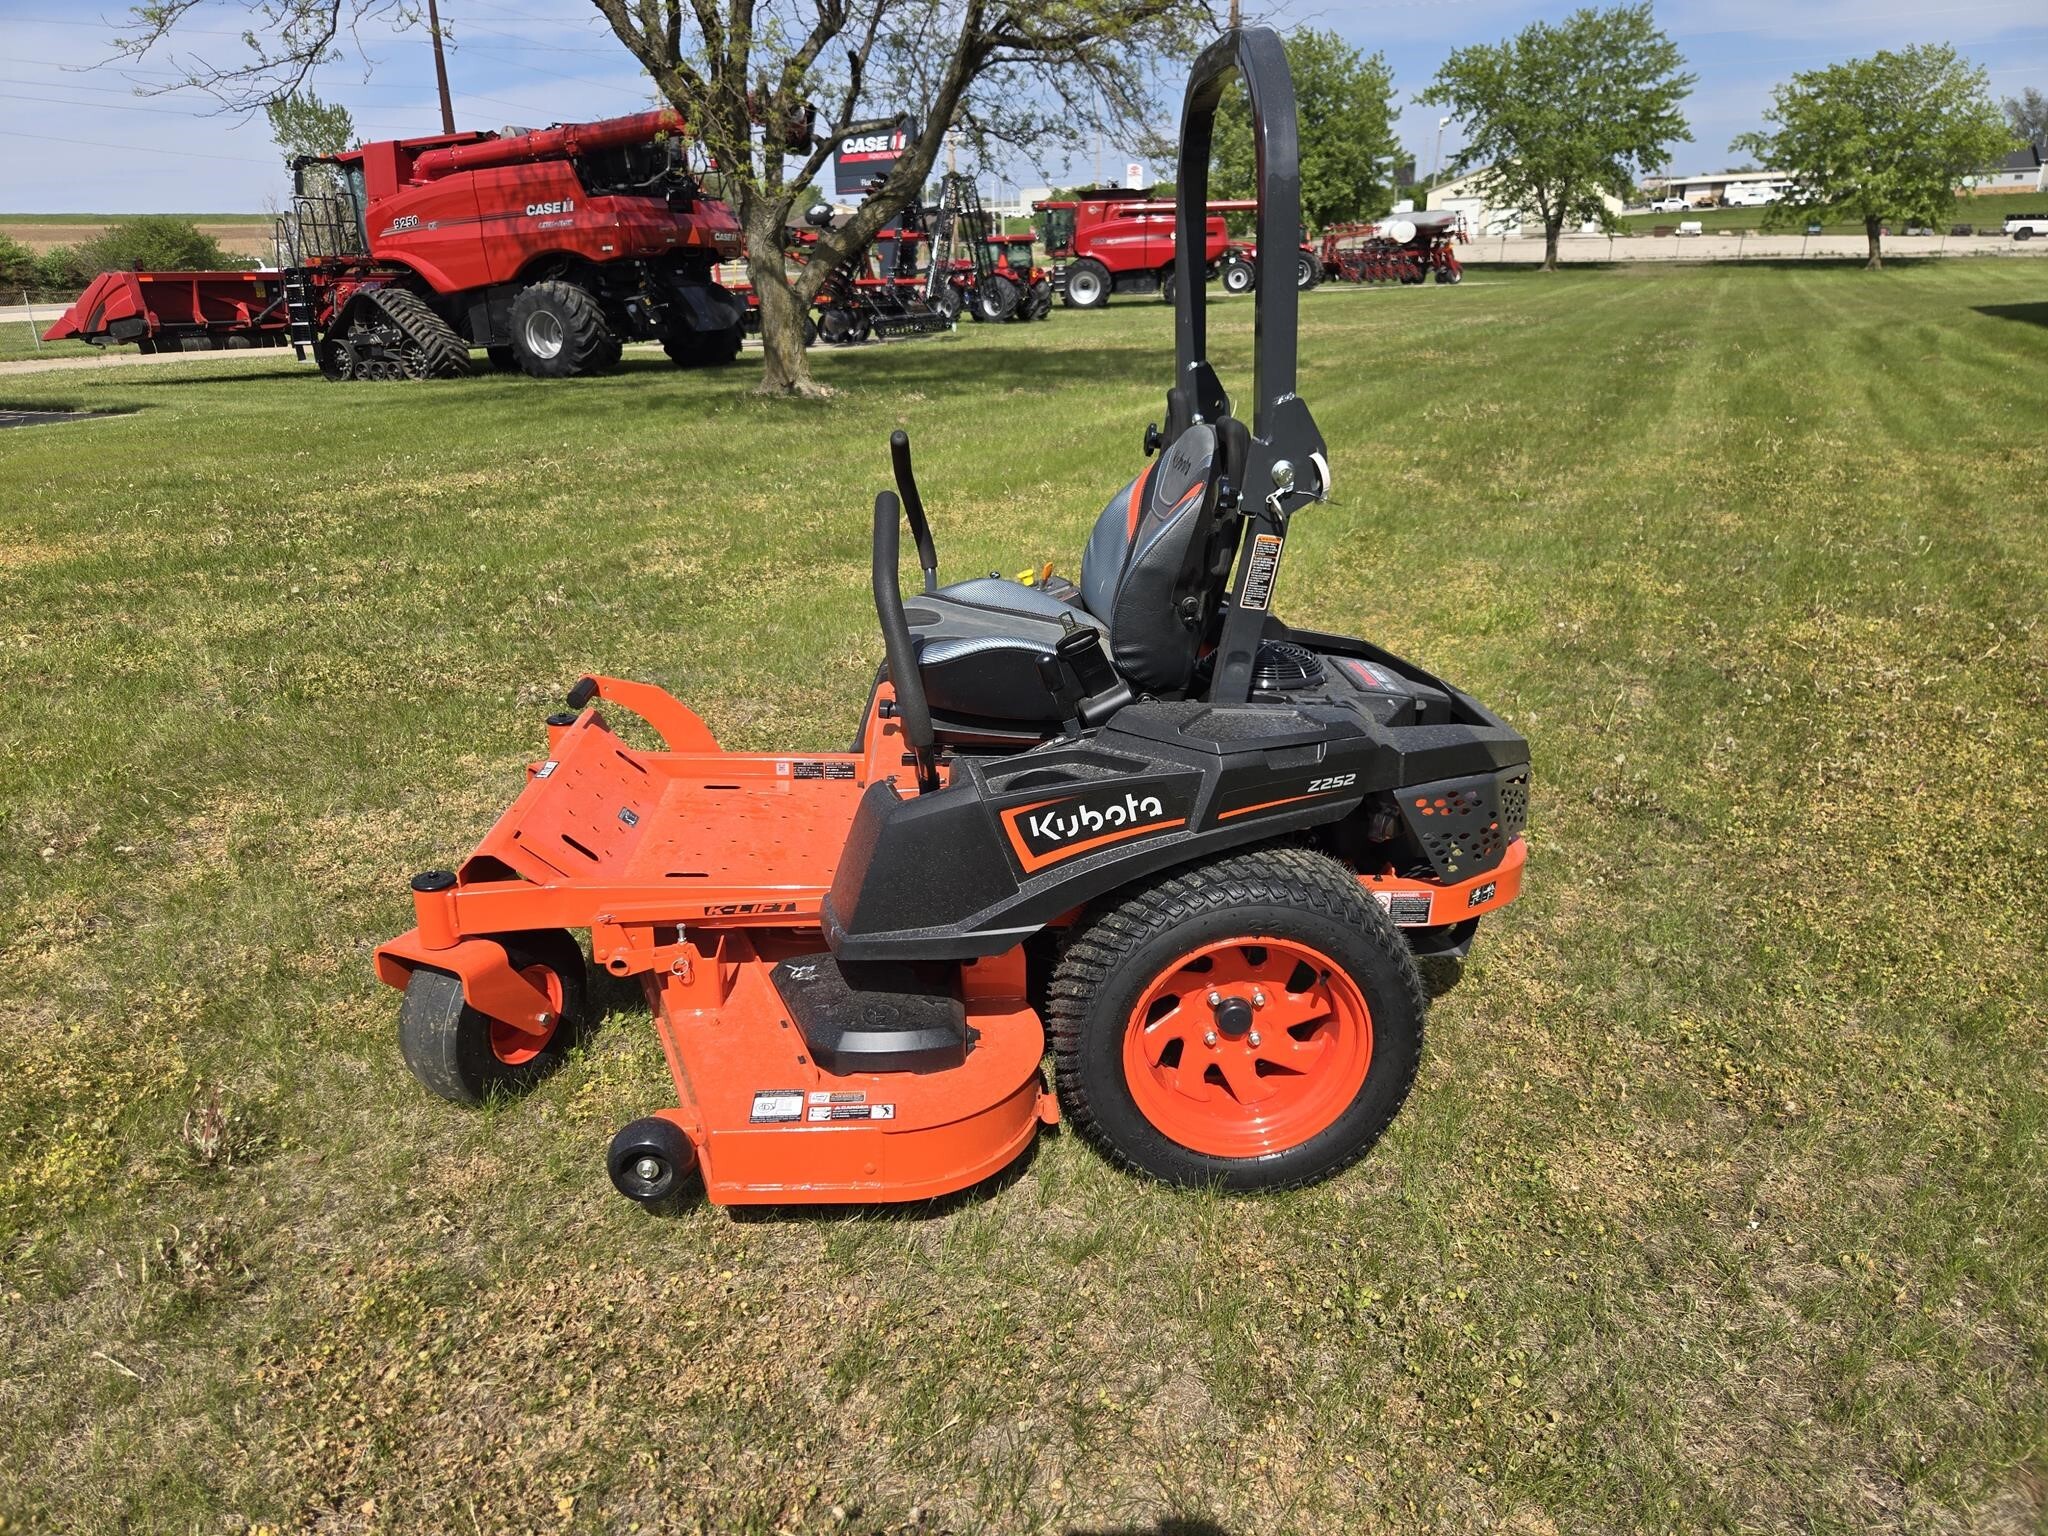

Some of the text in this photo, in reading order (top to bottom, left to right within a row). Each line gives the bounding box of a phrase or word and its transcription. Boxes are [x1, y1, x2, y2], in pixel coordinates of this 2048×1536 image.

[842, 136, 889, 154] CASE
[526, 202, 561, 216] CASE
[393, 215, 418, 229] 9250
[714, 232, 732, 241] CASE
[1307, 773, 1357, 793] Z252
[1028, 793, 1163, 841] Kubota
[706, 902, 791, 916] K-LIFT
